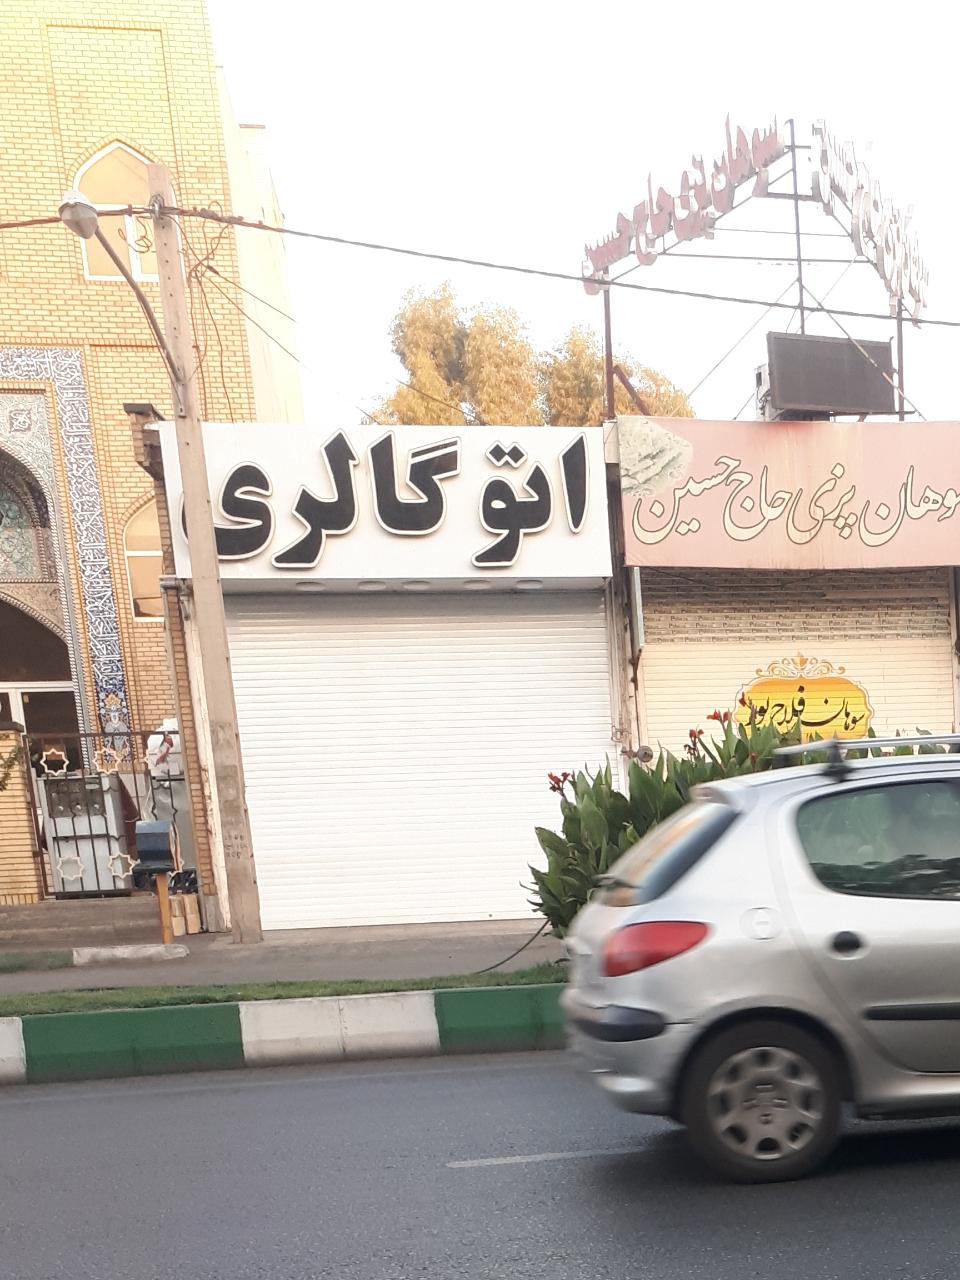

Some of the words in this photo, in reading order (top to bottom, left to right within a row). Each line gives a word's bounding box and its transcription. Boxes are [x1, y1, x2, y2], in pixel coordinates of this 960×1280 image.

[182, 428, 461, 569] گالری
[472, 431, 590, 567] اتو
[632, 456, 741, 544] حسین
[723, 466, 793, 541] حاج
[786, 463, 857, 545] پزی
[799, 697, 866, 731] سوهان
